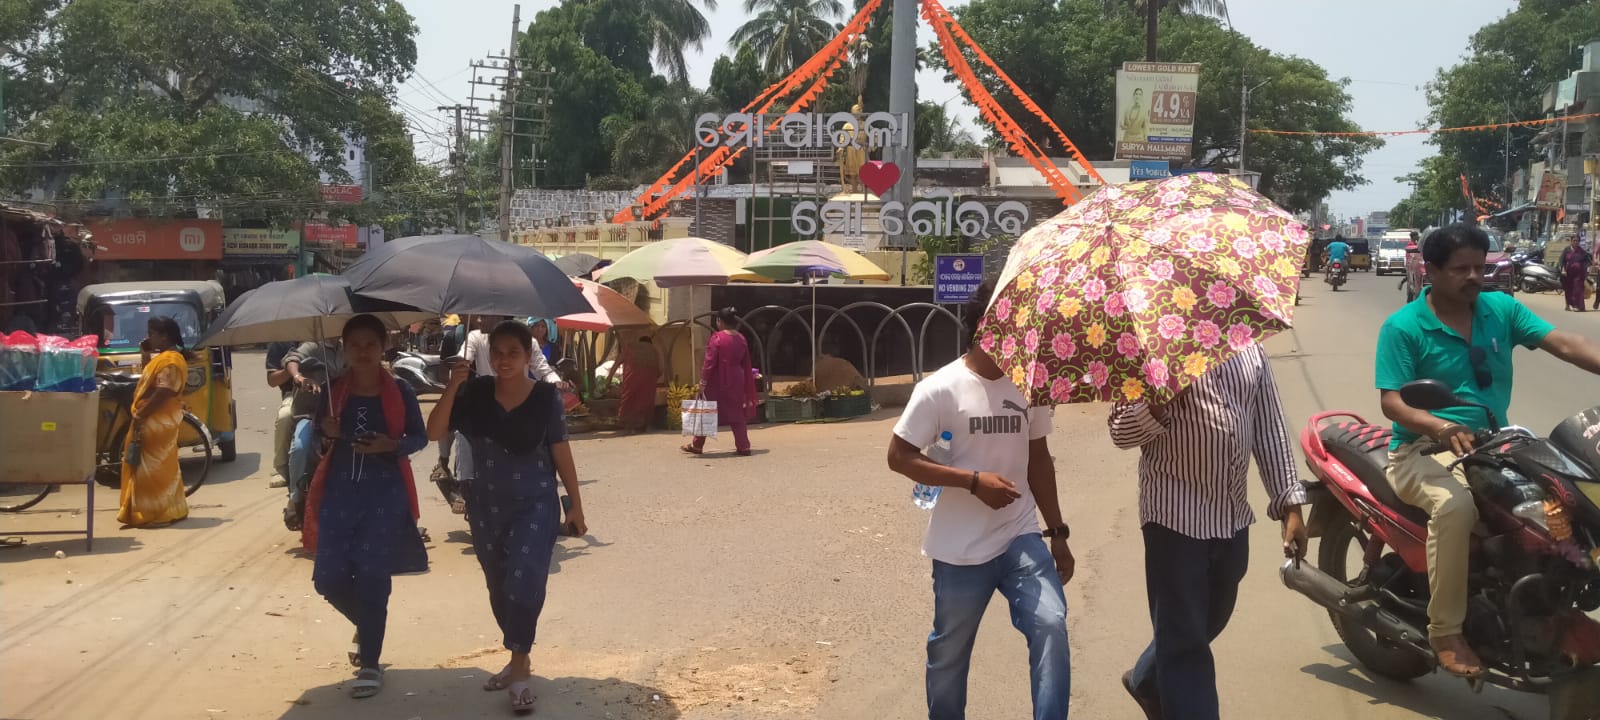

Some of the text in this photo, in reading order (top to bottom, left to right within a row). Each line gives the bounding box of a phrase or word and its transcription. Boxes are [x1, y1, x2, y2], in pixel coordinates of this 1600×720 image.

[1128, 64, 1155, 72] LOWEST
[1178, 65, 1196, 73] RATE
[1154, 93, 1180, 119] 4.9
[695, 112, 763, 148] ମୋ
[1121, 143, 1186, 153] SURYA HALLMARK
[792, 201, 862, 237] ମୋ
[938, 283, 946, 293] NO
[969, 415, 1021, 435] PUMA
